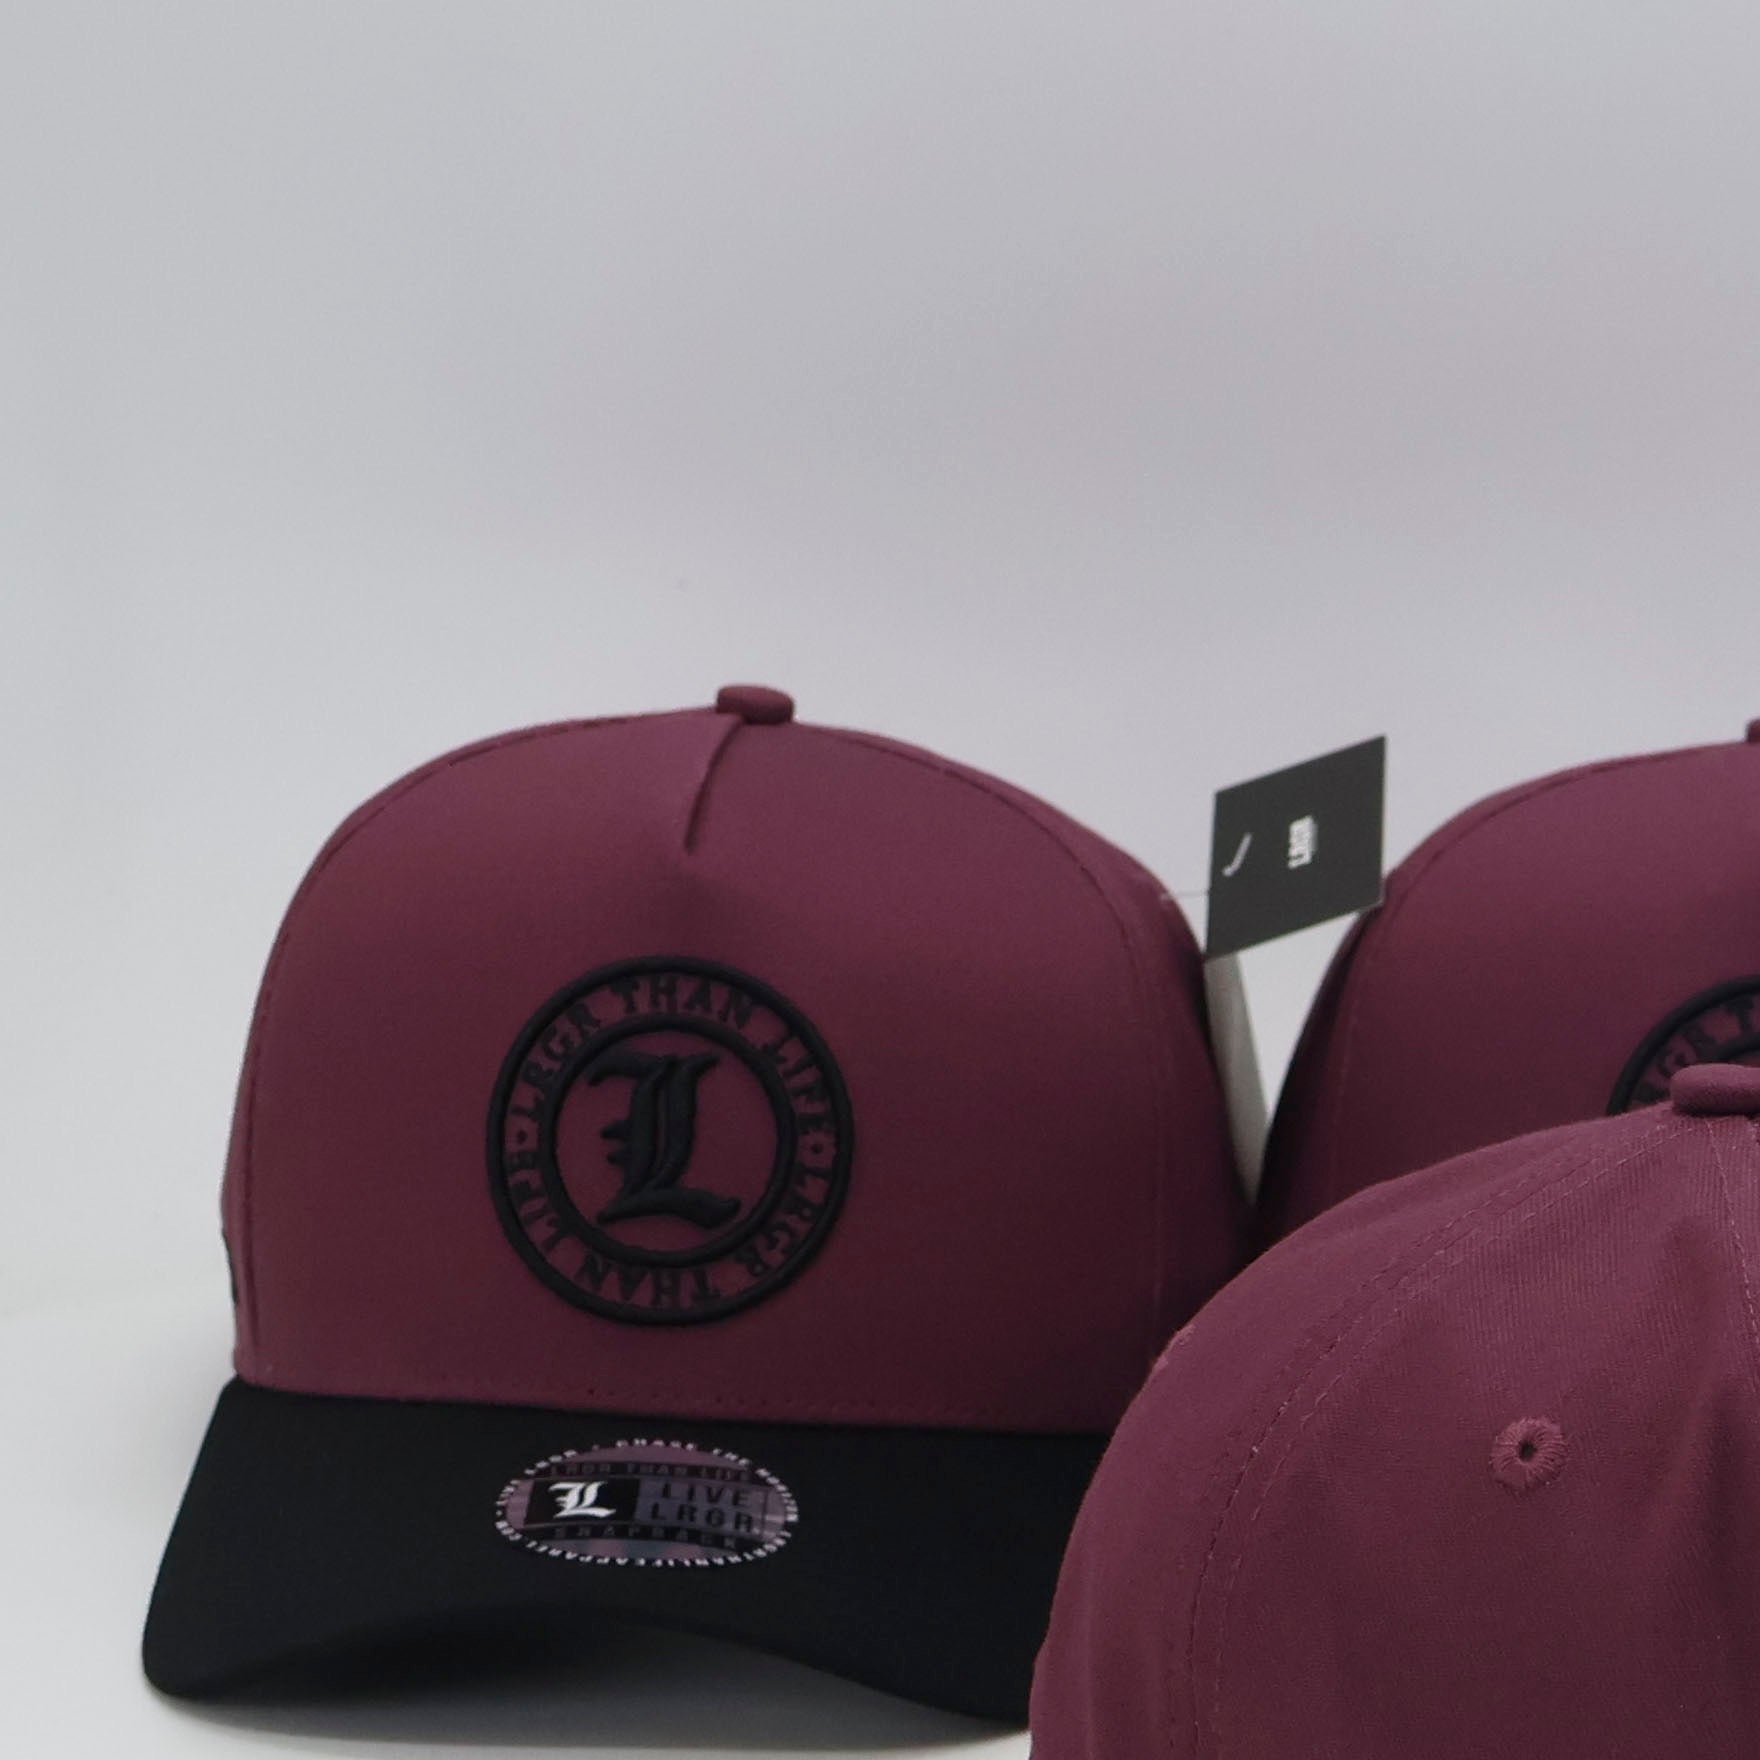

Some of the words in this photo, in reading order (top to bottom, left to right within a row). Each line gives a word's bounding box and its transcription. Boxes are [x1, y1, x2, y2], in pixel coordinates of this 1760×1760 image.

[511, 1003, 601, 1121] LRGR
[613, 974, 751, 1030] THAN
[759, 1024, 834, 1130] LIFE
[586, 1050, 742, 1230] L
[575, 1254, 721, 1308] THAN
[547, 1480, 617, 1520] L
